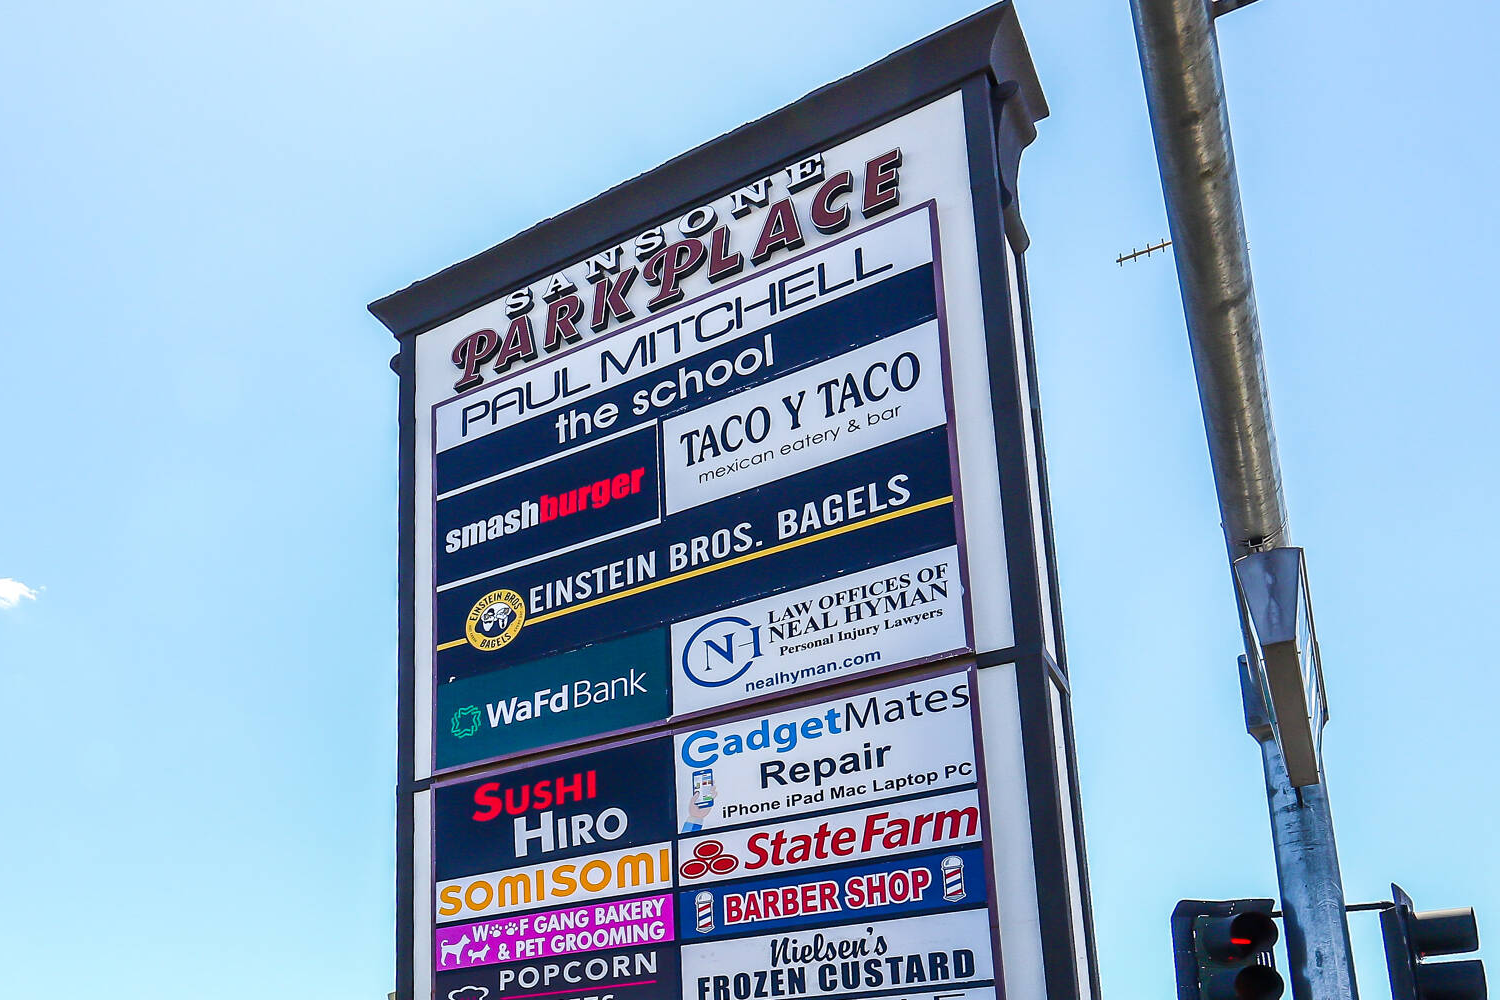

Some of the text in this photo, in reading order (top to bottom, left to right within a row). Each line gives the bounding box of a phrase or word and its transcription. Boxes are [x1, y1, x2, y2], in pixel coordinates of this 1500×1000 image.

[504, 152, 825, 318] SANSONE
[451, 147, 902, 393] PARK PLACE
[461, 247, 894, 437] PAUL MITCHELL
[555, 333, 774, 444] the school
[680, 352, 921, 467] TACO Y TACO
[699, 405, 902, 484] mexican eatery & bar
[445, 467, 645, 554] smashburger
[529, 474, 911, 614] EINSTEIN BROS. BAGELS
[470, 592, 523, 621] EINSTEIN BROS
[767, 562, 948, 625] LAW OFFICES OF
[768, 580, 949, 644] NEAL HYMAN
[480, 632, 512, 648] BAGELS
[779, 607, 943, 656] Personal Injury Lawyers
[485, 668, 647, 728] WaFd Bank
[745, 650, 881, 692] nealhyman.com
[681, 683, 970, 768] GadgetMates
[722, 761, 973, 819] iPhone iPad Mac Laptop PC
[760, 743, 891, 789] Repair
[472, 770, 597, 822] SUSHI
[513, 807, 628, 858] HIRO
[533, 909, 590, 934] GANG
[594, 897, 666, 925] BAKERY
[724, 867, 932, 925] BARBER SHOP
[497, 921, 666, 961] & PET GROOMING
[770, 927, 888, 967] Nielsen's
[818, 949, 976, 990] CUSTARD
[499, 951, 657, 991] POPCORN
